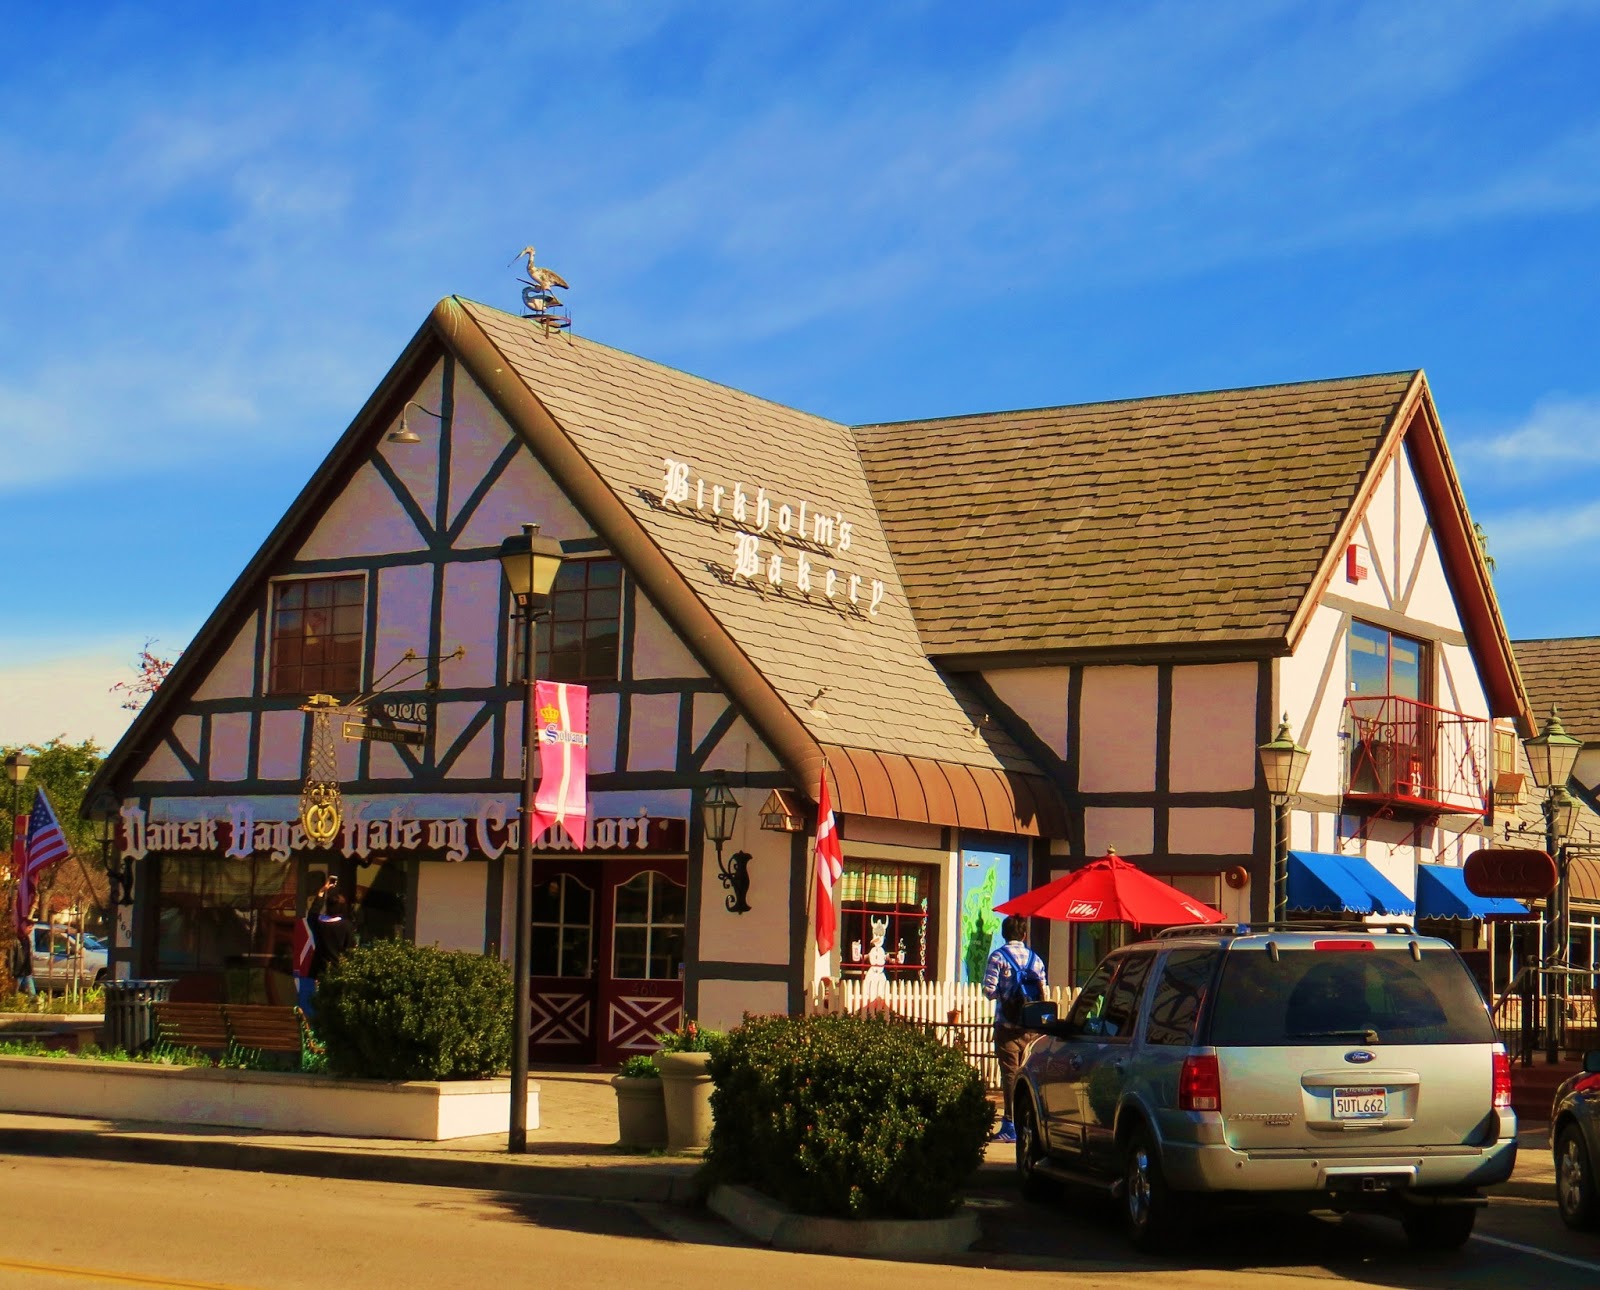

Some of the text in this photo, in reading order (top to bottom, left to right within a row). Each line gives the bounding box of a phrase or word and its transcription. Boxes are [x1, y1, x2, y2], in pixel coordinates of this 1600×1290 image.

[661, 458, 853, 553] Birkholm's
[732, 532, 884, 616] Bakery
[545, 723, 585, 749] Solvang
[119, 805, 219, 860] Dansk
[427, 817, 470, 863] og
[1069, 903, 1098, 916] illy
[1336, 1099, 1384, 1113] 5UTL662
